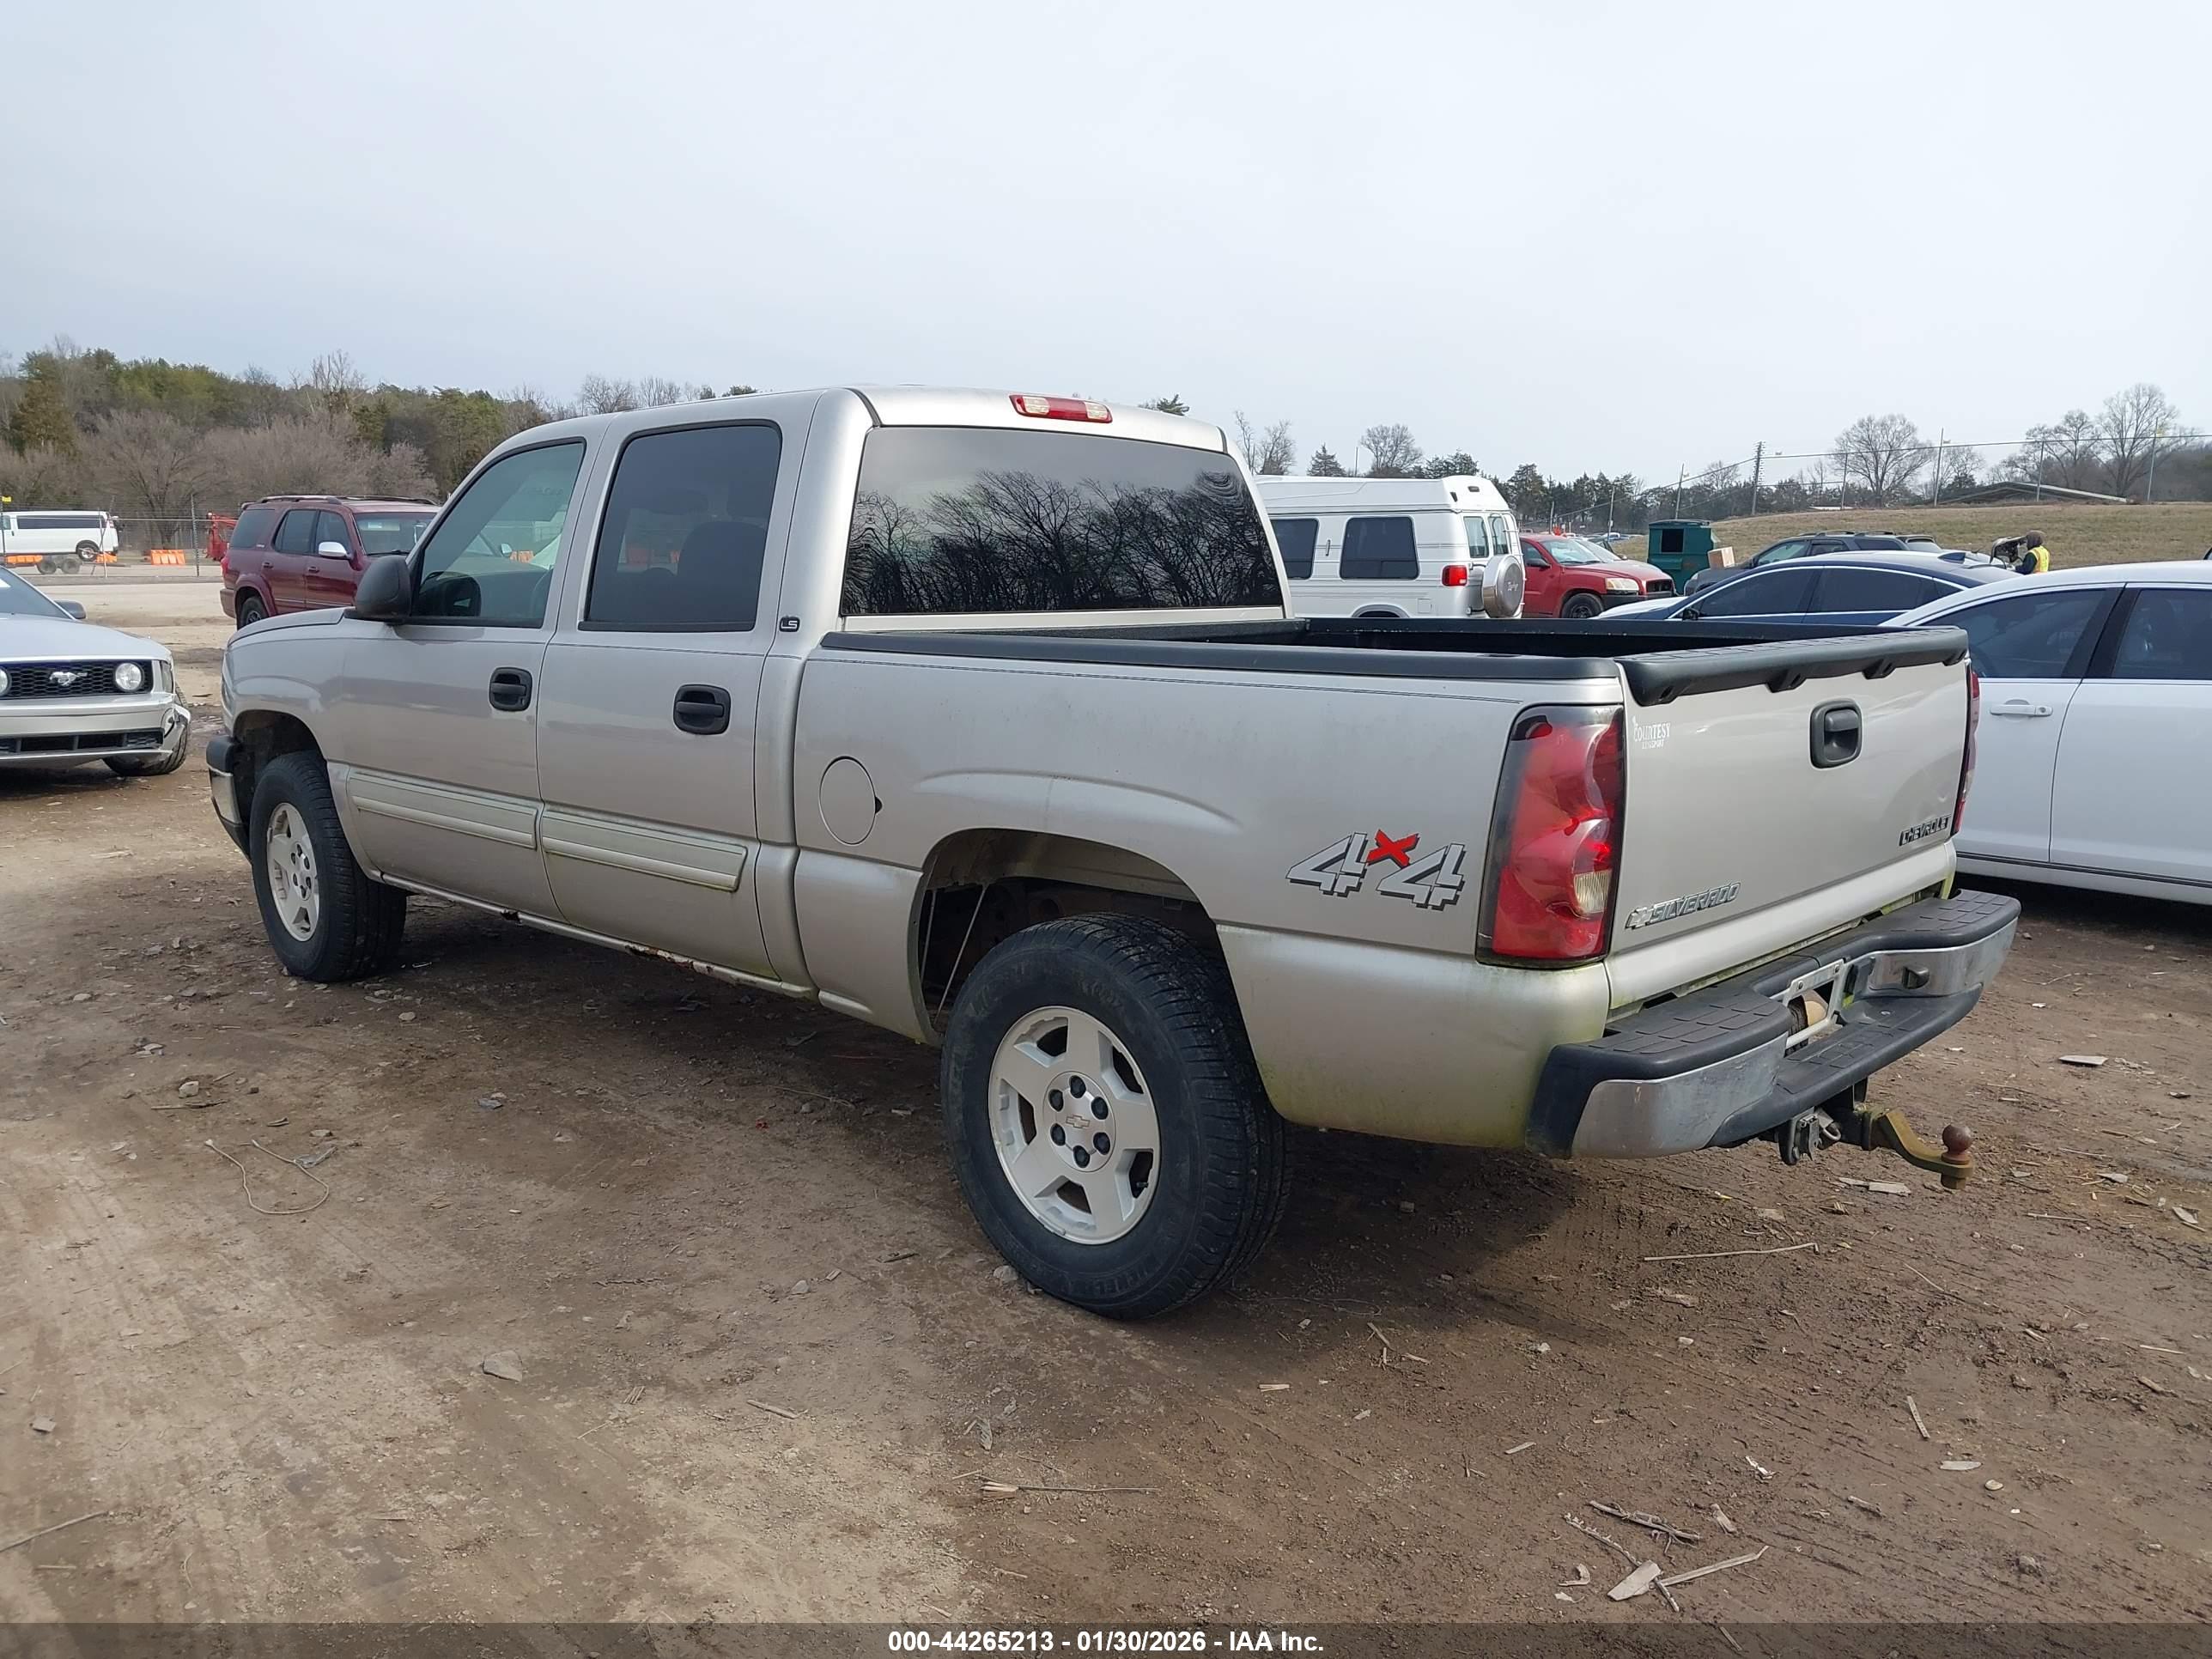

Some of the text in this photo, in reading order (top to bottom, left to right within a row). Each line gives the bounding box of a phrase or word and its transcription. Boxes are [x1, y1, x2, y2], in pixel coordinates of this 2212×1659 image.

[781, 618, 799, 630] LS
[1633, 722, 1670, 742] COURTESY
[1899, 814, 1952, 847] CHEVROLET
[1648, 882, 1741, 926] SILVERADO
